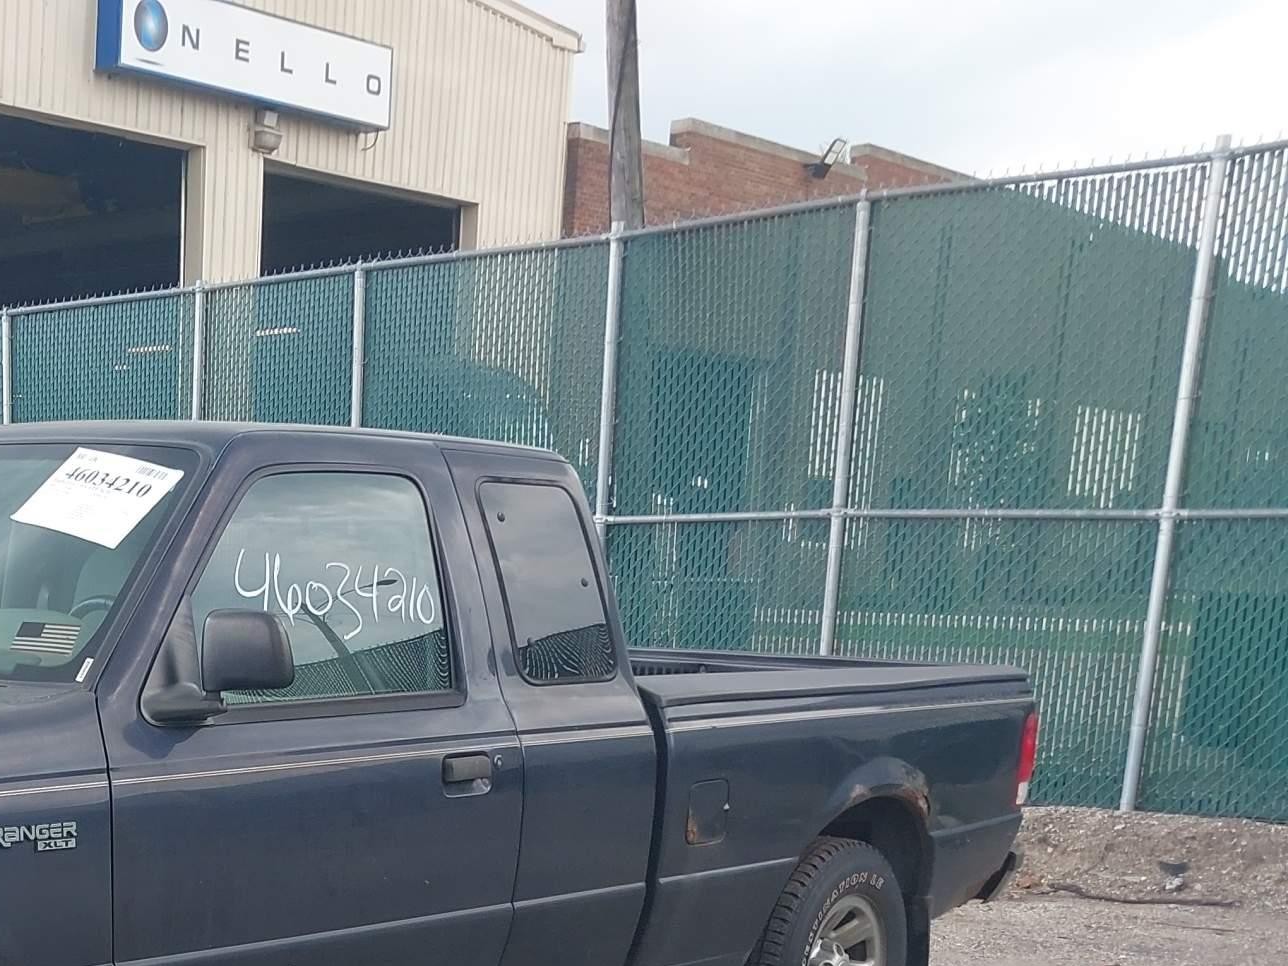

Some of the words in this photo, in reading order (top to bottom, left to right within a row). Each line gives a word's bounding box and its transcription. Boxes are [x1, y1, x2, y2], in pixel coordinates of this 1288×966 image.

[64, 466, 153, 498] 46034210
[233, 548, 437, 640] 46034210
[40, 839, 73, 849] XLT
